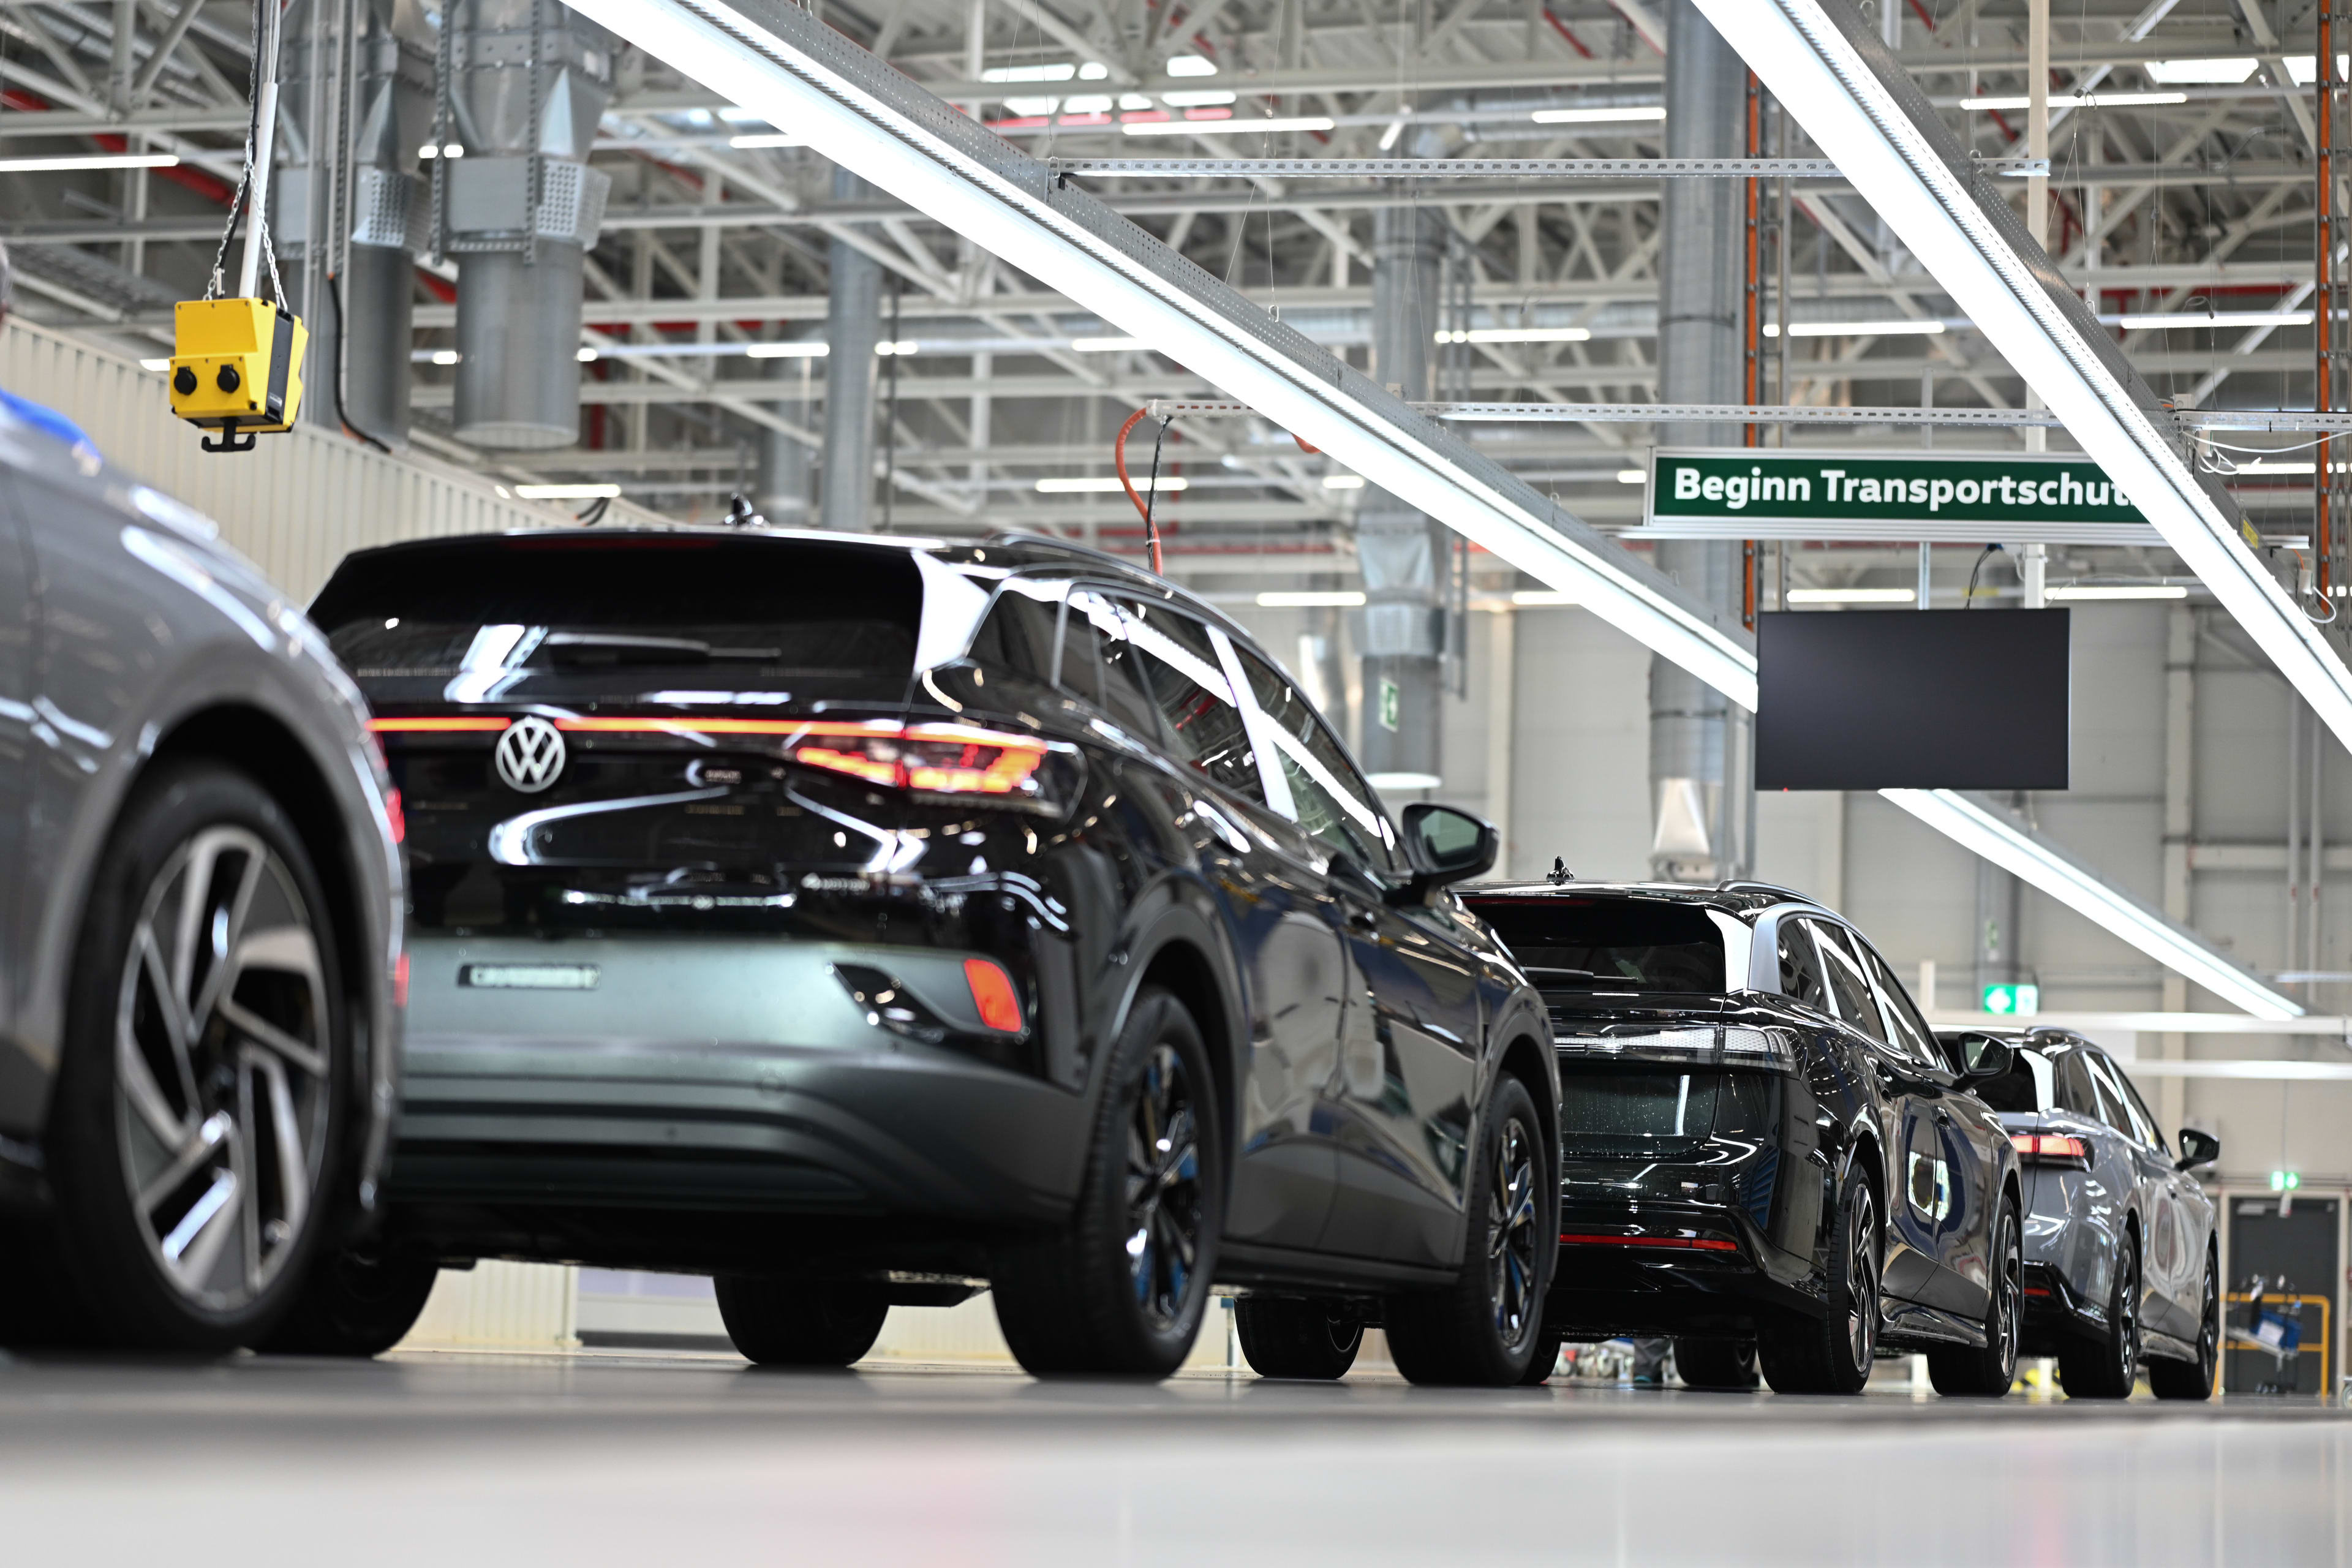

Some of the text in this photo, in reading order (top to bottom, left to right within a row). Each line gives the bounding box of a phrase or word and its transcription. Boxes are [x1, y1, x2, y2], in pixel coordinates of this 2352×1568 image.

[1675, 467, 2134, 511] Beginn Transportschut
[496, 717, 565, 792] VW
